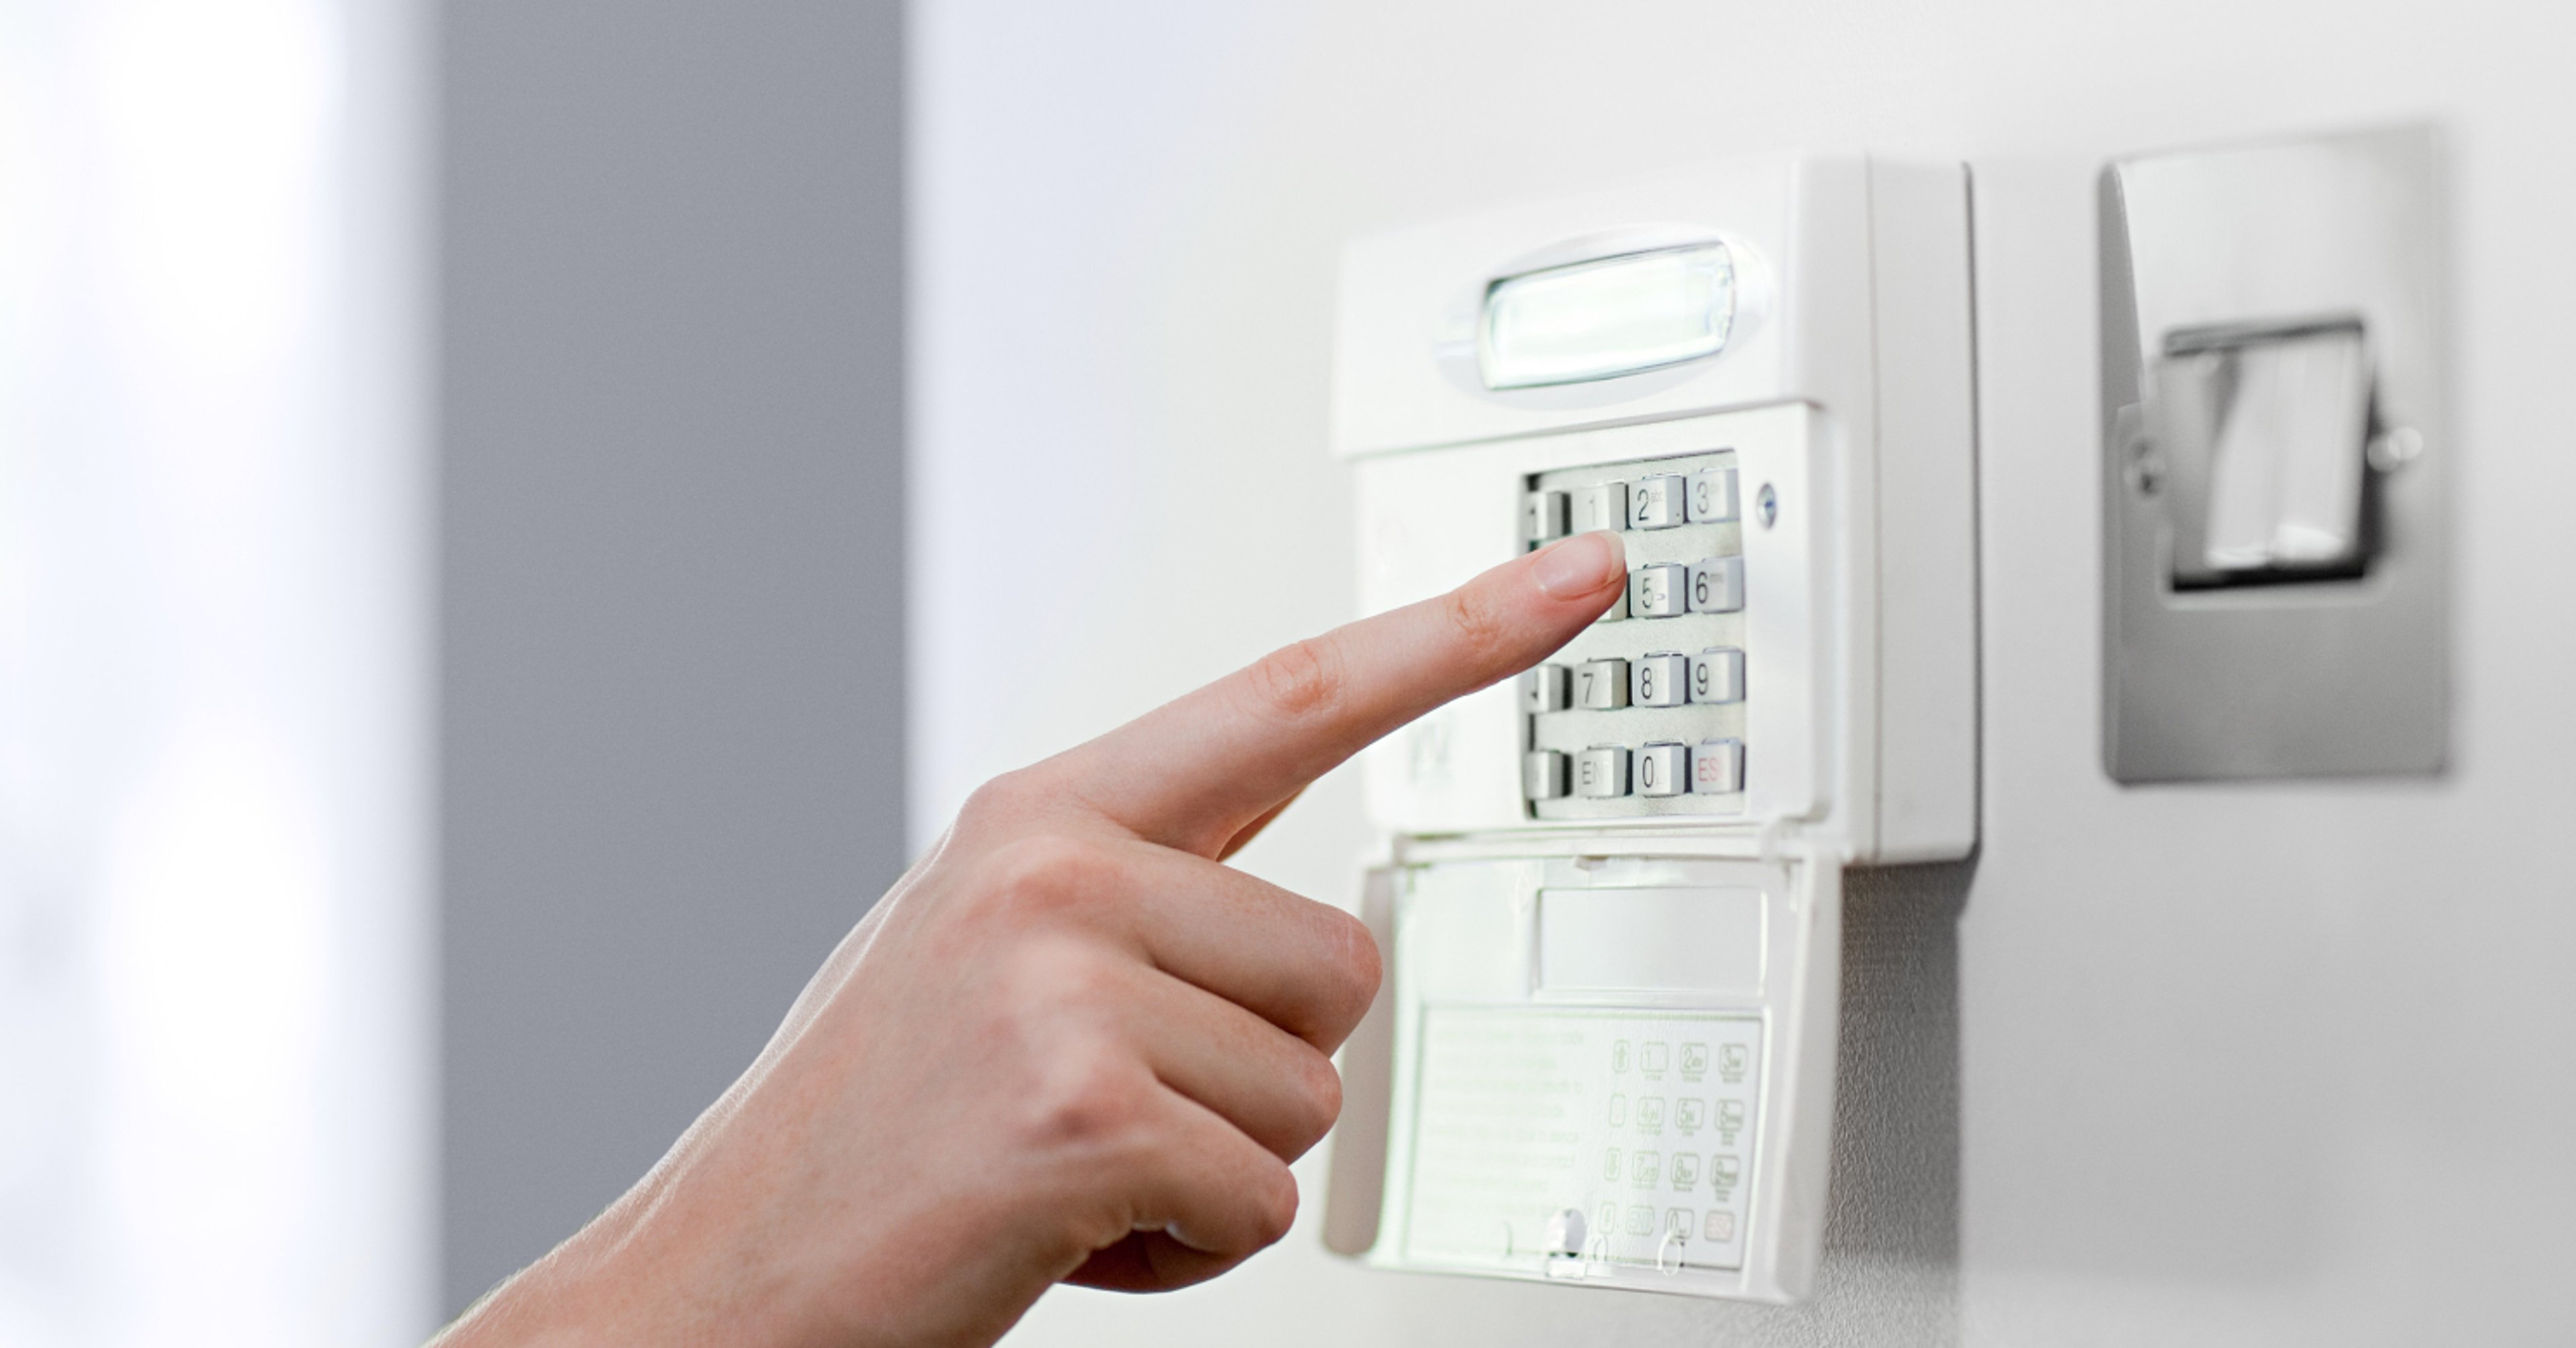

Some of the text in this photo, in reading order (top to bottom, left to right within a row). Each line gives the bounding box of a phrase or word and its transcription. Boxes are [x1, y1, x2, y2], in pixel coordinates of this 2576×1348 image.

[1588, 495, 1597, 527] 1
[1637, 488, 1650, 521] 2
[1696, 481, 1709, 515] 3
[1642, 577, 1654, 610] 5
[1695, 571, 1709, 605] 6
[1582, 672, 1594, 704] 7
[1640, 667, 1653, 700] 8
[1697, 662, 1709, 696] 9
[1642, 756, 1654, 788] 0
